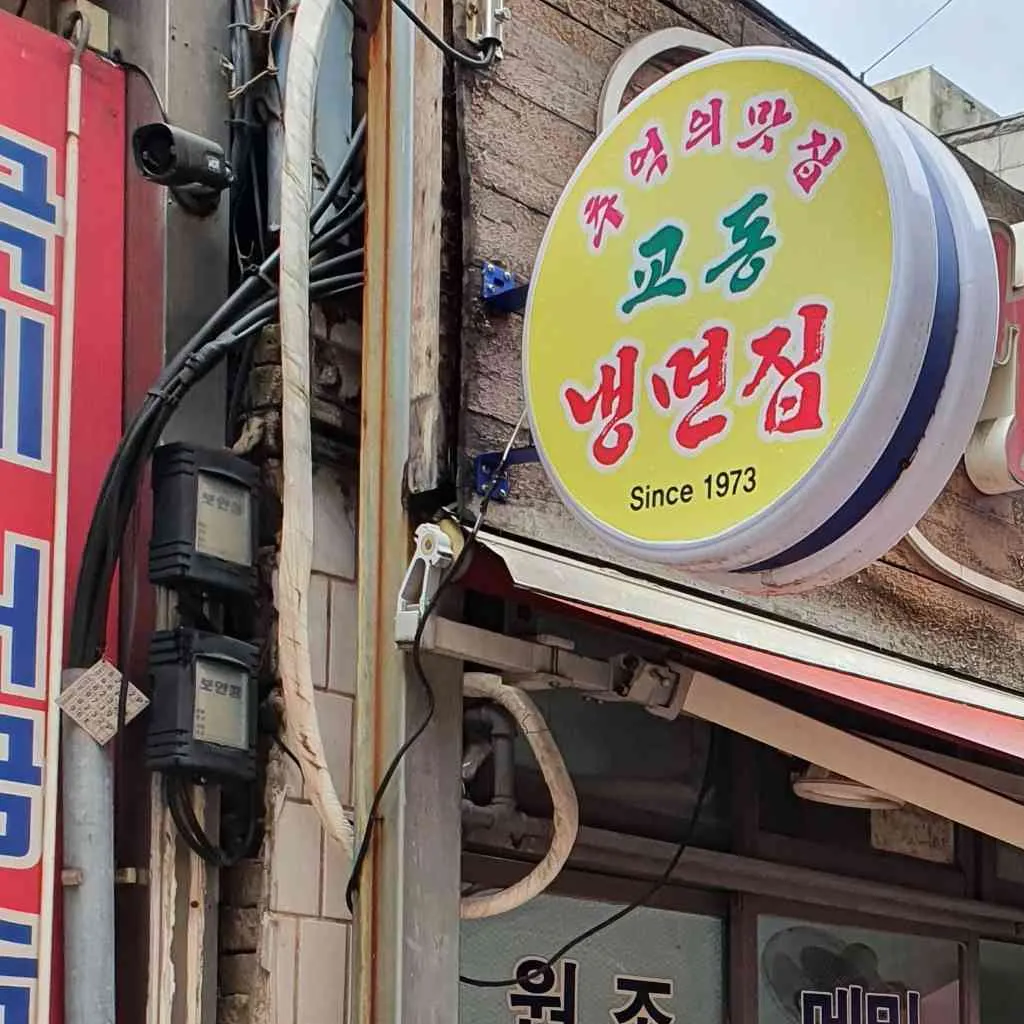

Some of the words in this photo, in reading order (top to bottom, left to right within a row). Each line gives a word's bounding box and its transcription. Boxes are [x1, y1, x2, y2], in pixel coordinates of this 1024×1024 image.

[620, 194, 777, 314] 교동
[564, 303, 829, 466] 냉면집
[630, 484, 694, 511] Since
[704, 466, 757, 499] 1973
